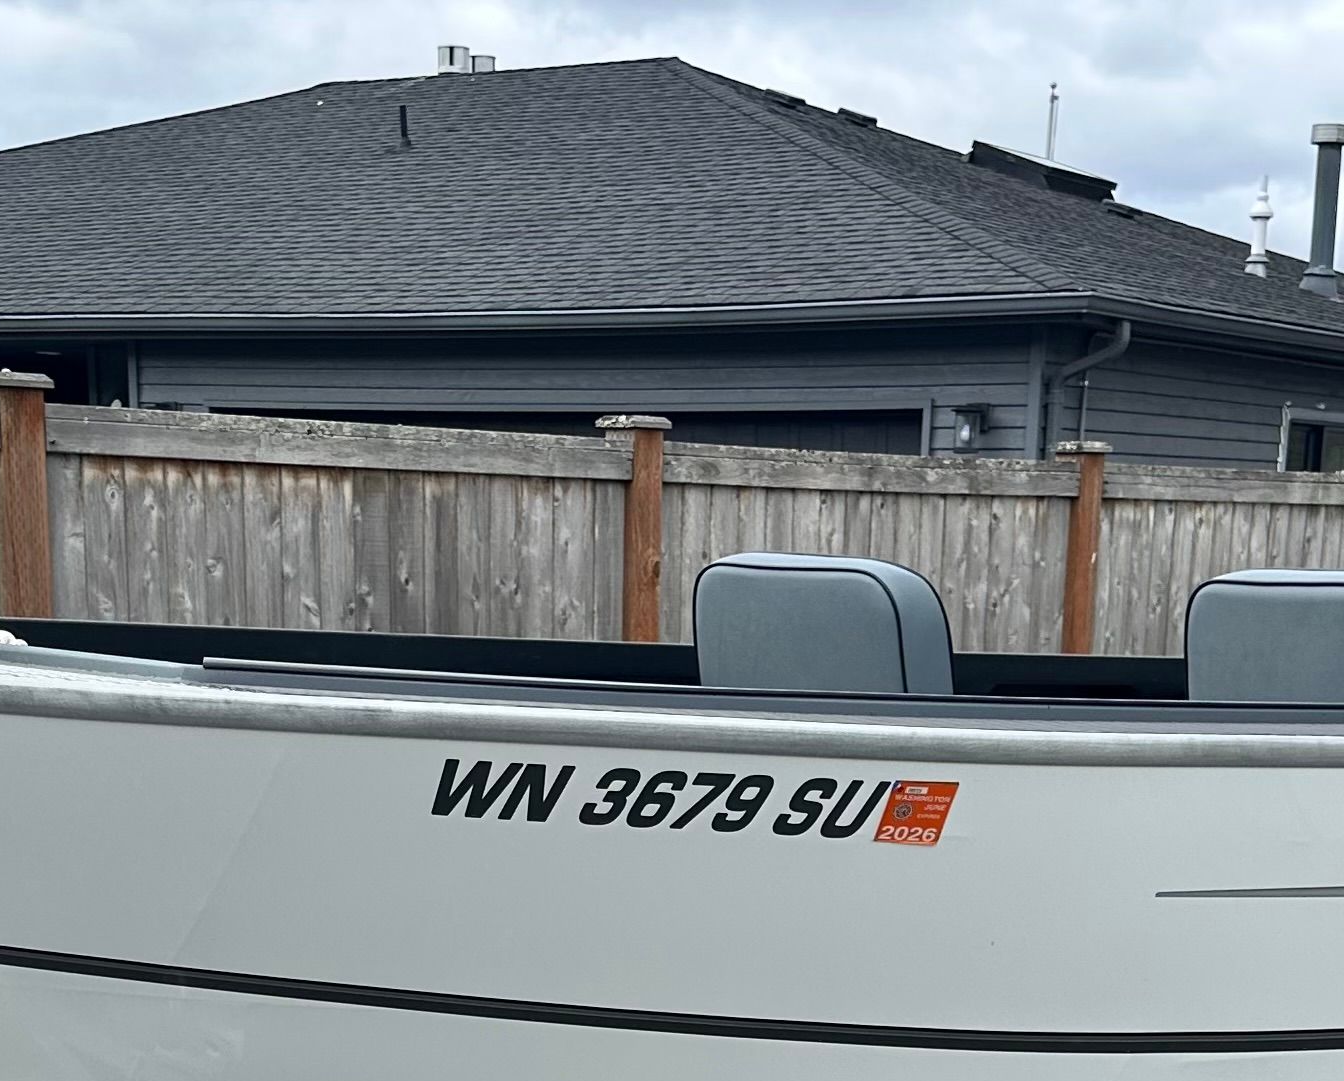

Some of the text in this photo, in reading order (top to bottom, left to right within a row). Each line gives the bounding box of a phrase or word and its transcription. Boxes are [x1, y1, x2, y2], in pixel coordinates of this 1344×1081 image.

[431, 758, 892, 839] WN 3679 SU
[877, 825, 938, 843] 2026
